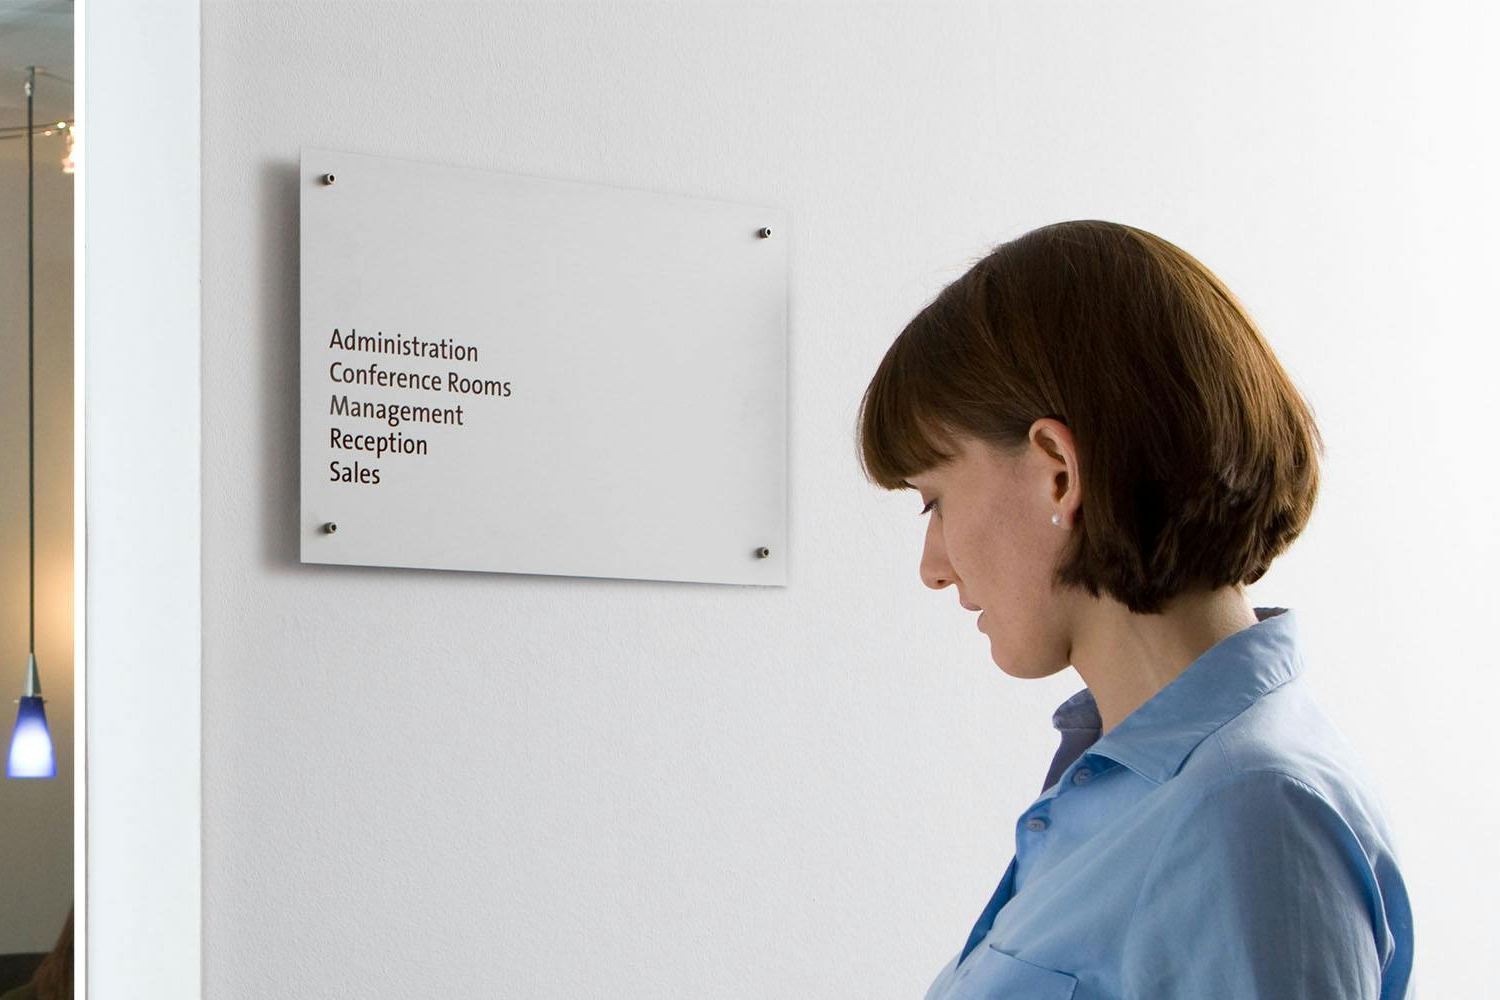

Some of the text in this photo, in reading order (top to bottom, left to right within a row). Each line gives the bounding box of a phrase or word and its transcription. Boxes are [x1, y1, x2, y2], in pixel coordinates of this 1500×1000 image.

[329, 328, 478, 362] Administration
[329, 361, 512, 397] Conference Rooms
[329, 394, 464, 427] Management
[330, 427, 428, 459] Reception
[329, 460, 381, 484] Sales
